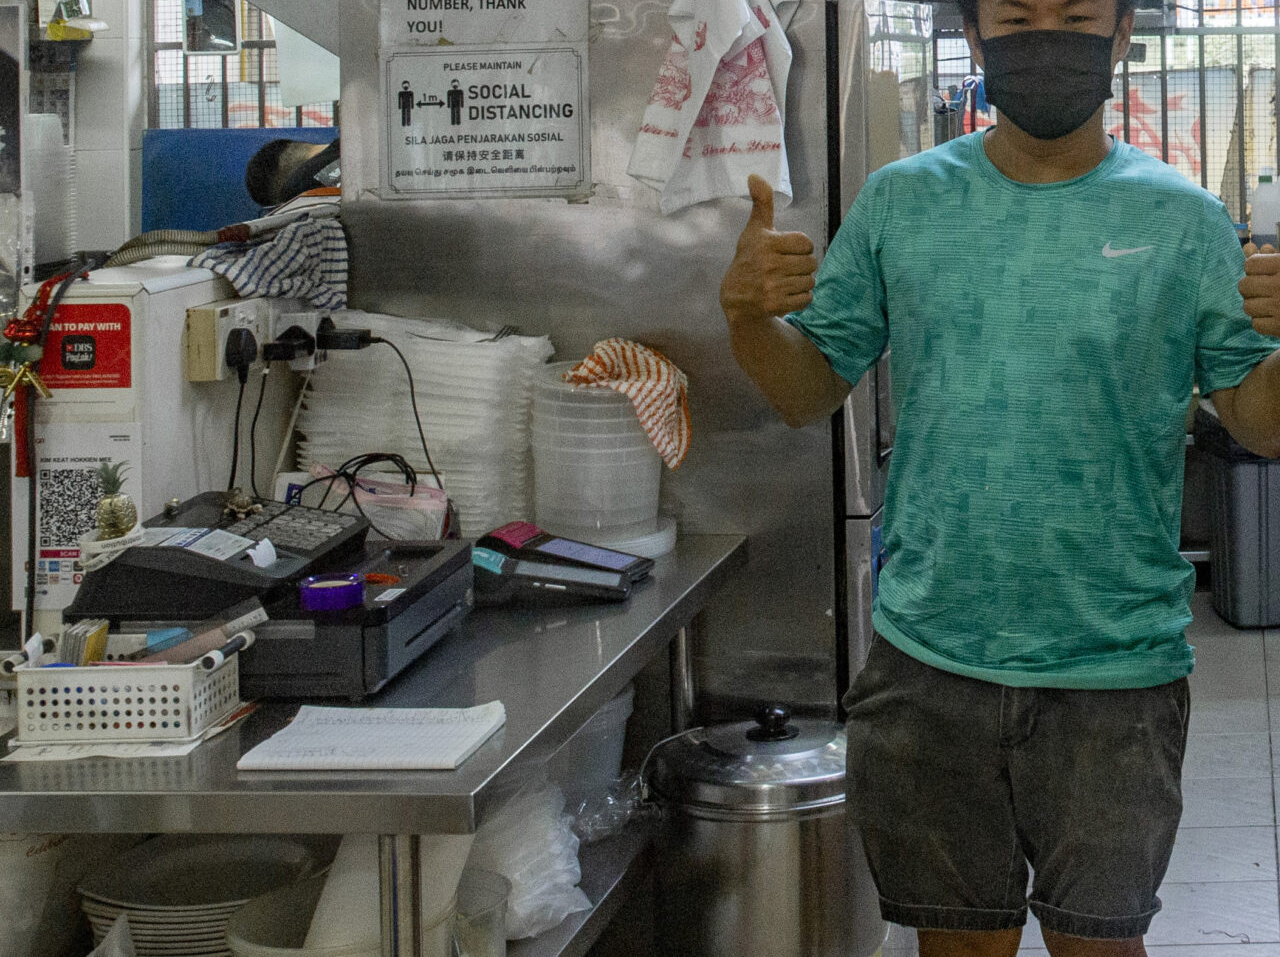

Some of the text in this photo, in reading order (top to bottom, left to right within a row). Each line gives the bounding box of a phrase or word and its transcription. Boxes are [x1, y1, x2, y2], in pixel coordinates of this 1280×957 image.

[407, 0, 473, 11] NUMBER,
[407, 21, 443, 32] YOU!
[444, 62, 521, 71] PLEASE MAINTAIN
[468, 84, 531, 99] SOCIAL
[469, 104, 573, 120] DISTANCING
[405, 133, 563, 145] SILA JAGA PENJARAKAN SOSIAL
[443, 149, 525, 161] 请保持安全距离
[64, 323, 76, 331] TO
[78, 323, 95, 331] PAY
[96, 323, 121, 331] WITH
[74, 343, 92, 351] DBS
